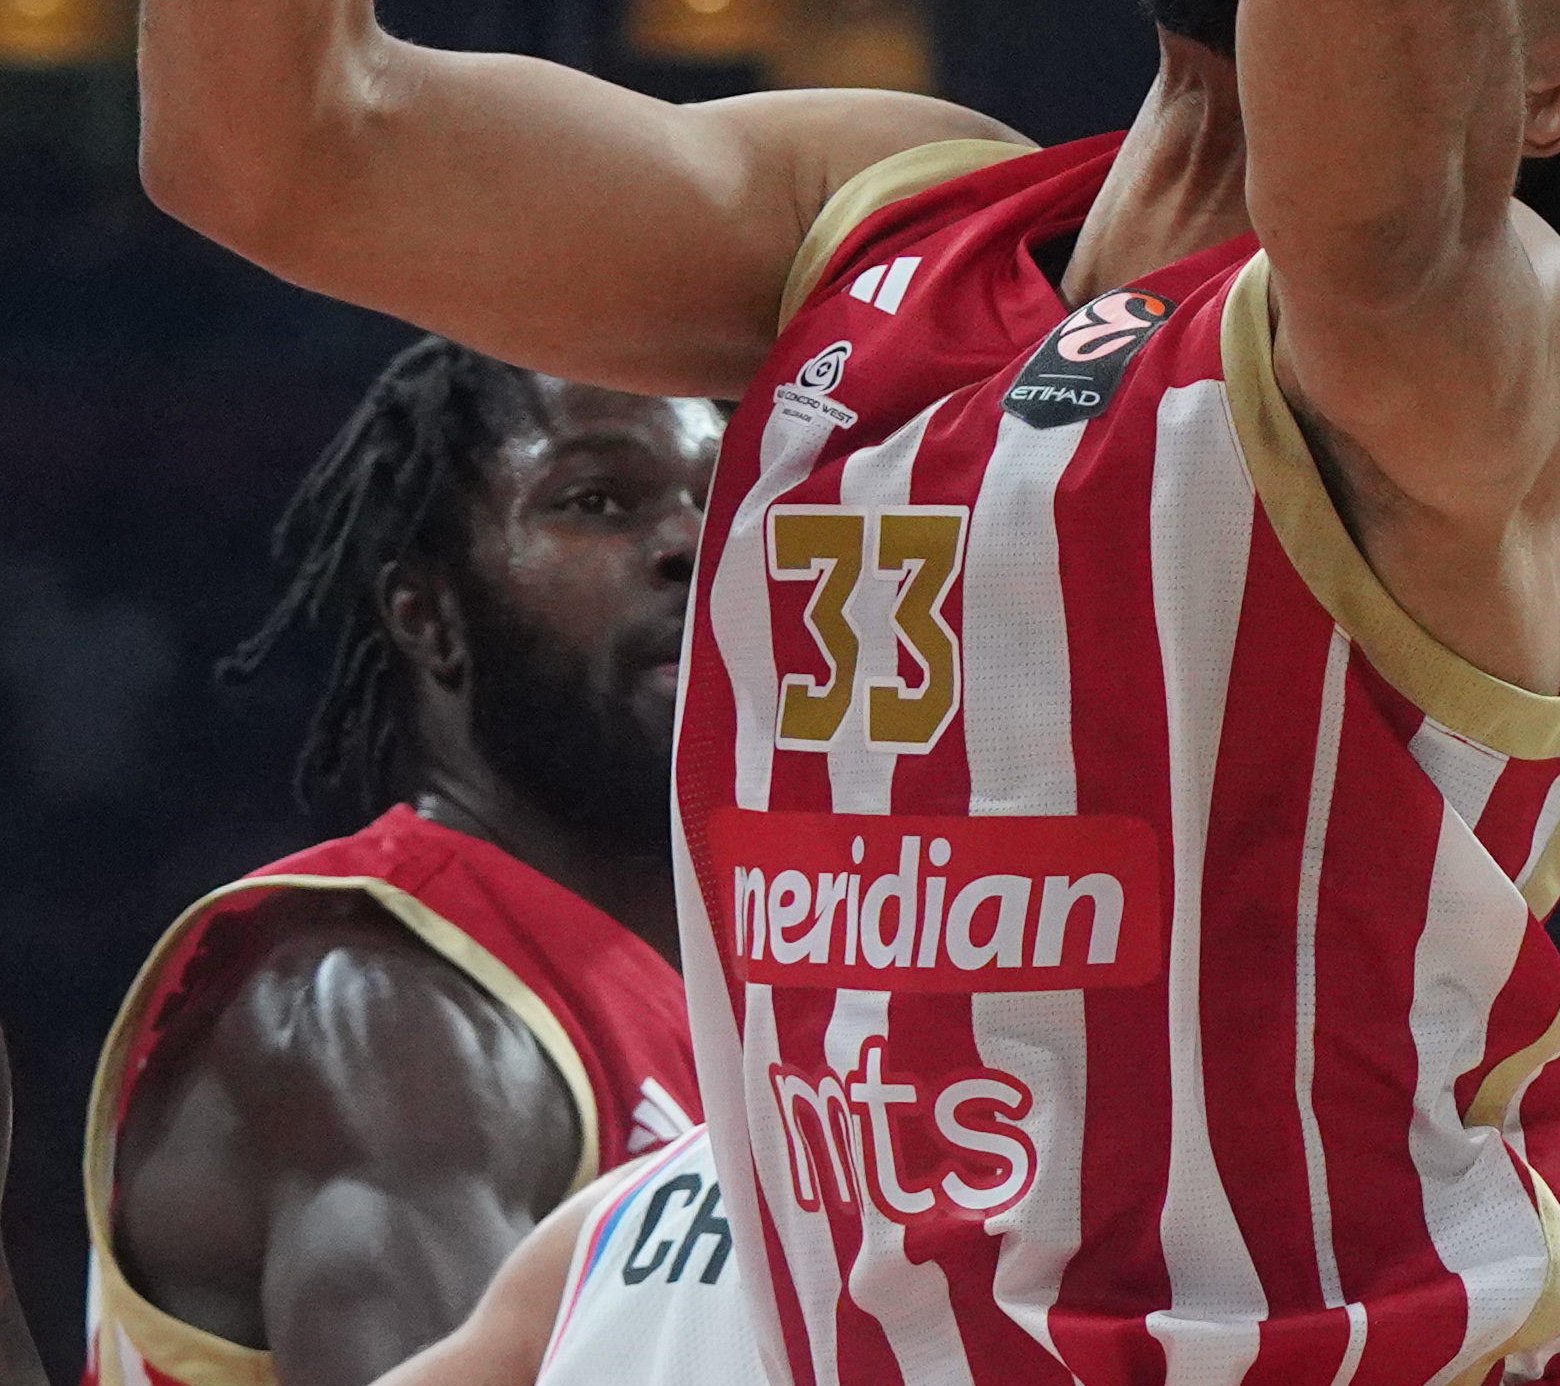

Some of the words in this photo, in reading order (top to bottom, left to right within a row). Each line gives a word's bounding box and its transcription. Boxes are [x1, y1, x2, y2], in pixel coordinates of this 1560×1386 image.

[822, 403, 854, 424] WEST
[1011, 386, 1100, 406] ETIHAD
[766, 505, 969, 753] 33
[734, 835, 1124, 971] meridian
[778, 1043, 1032, 1215] mts
